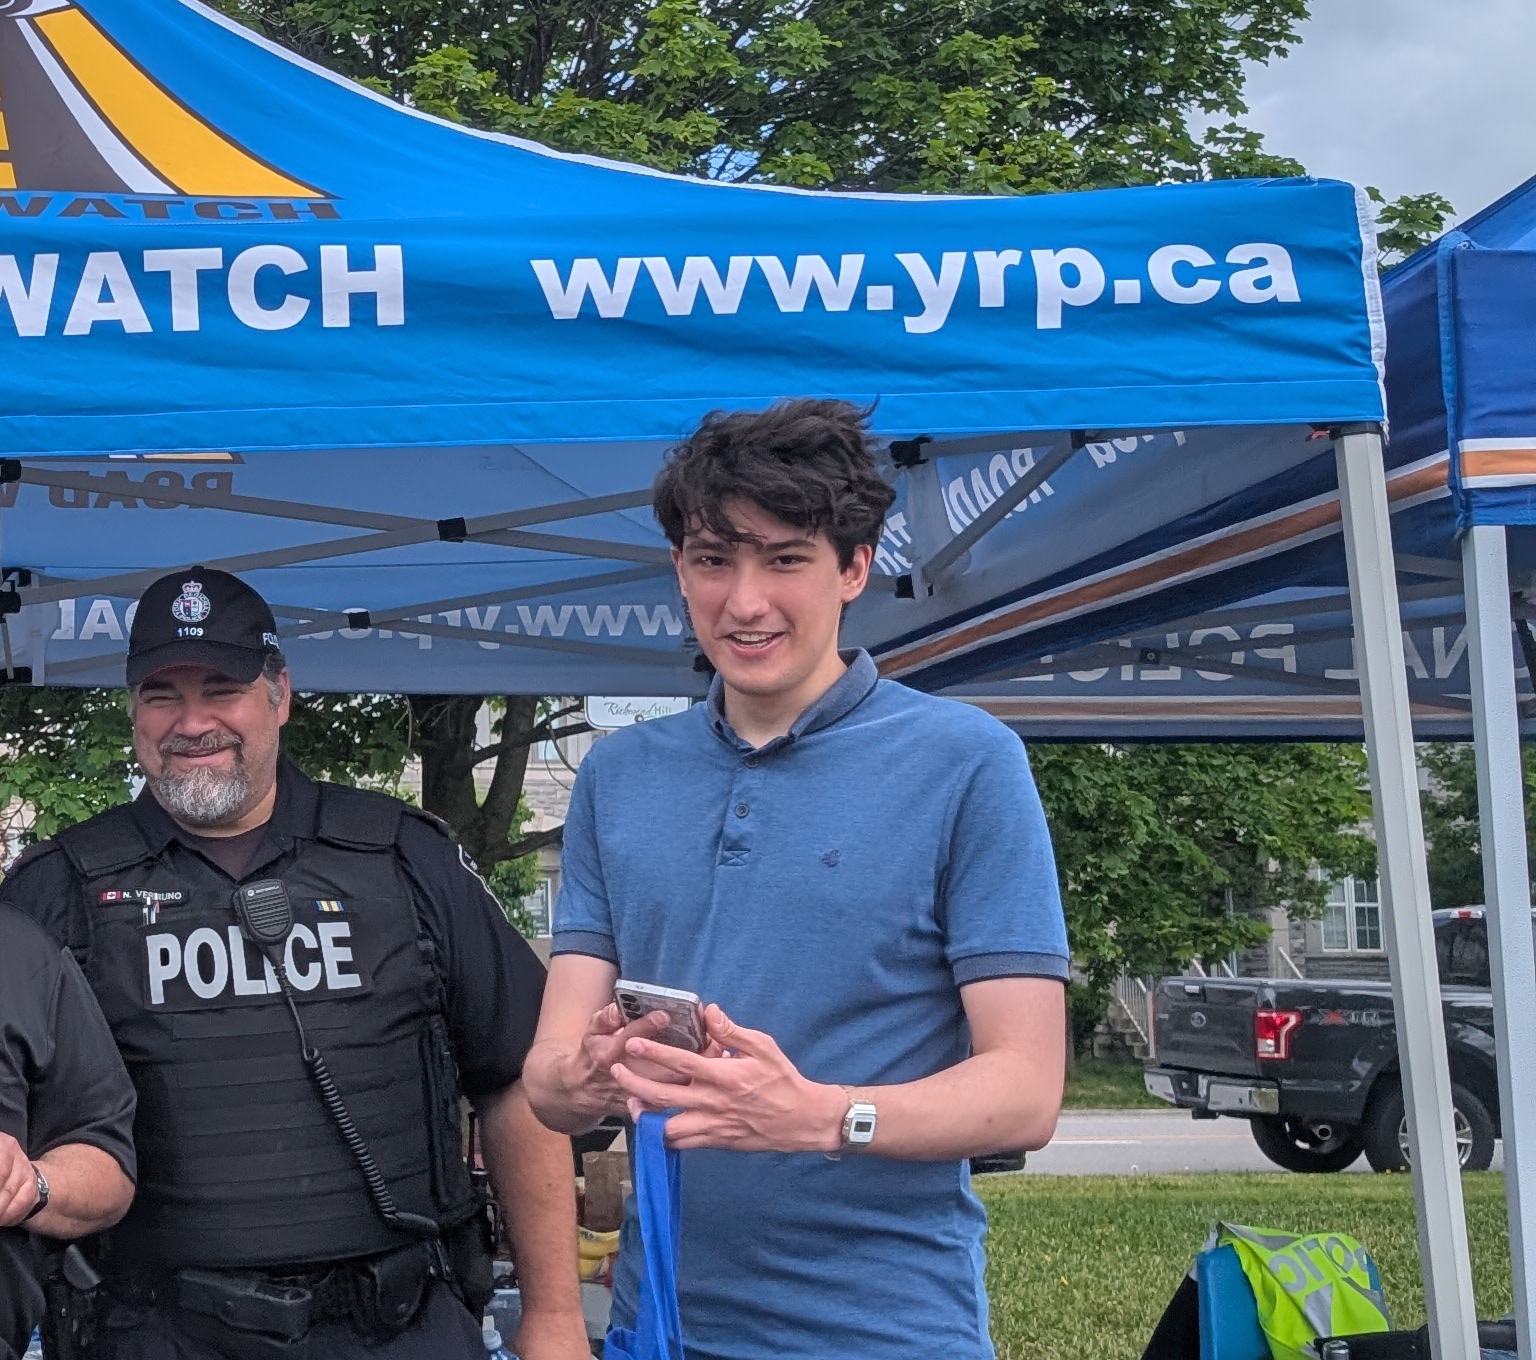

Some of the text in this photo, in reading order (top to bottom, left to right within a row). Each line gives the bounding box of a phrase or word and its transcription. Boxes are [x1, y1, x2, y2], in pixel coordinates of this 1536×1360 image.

[531, 243, 1300, 334] www.yrp.ca
[177, 627, 204, 637] 1109
[122, 891, 133, 899] N.
